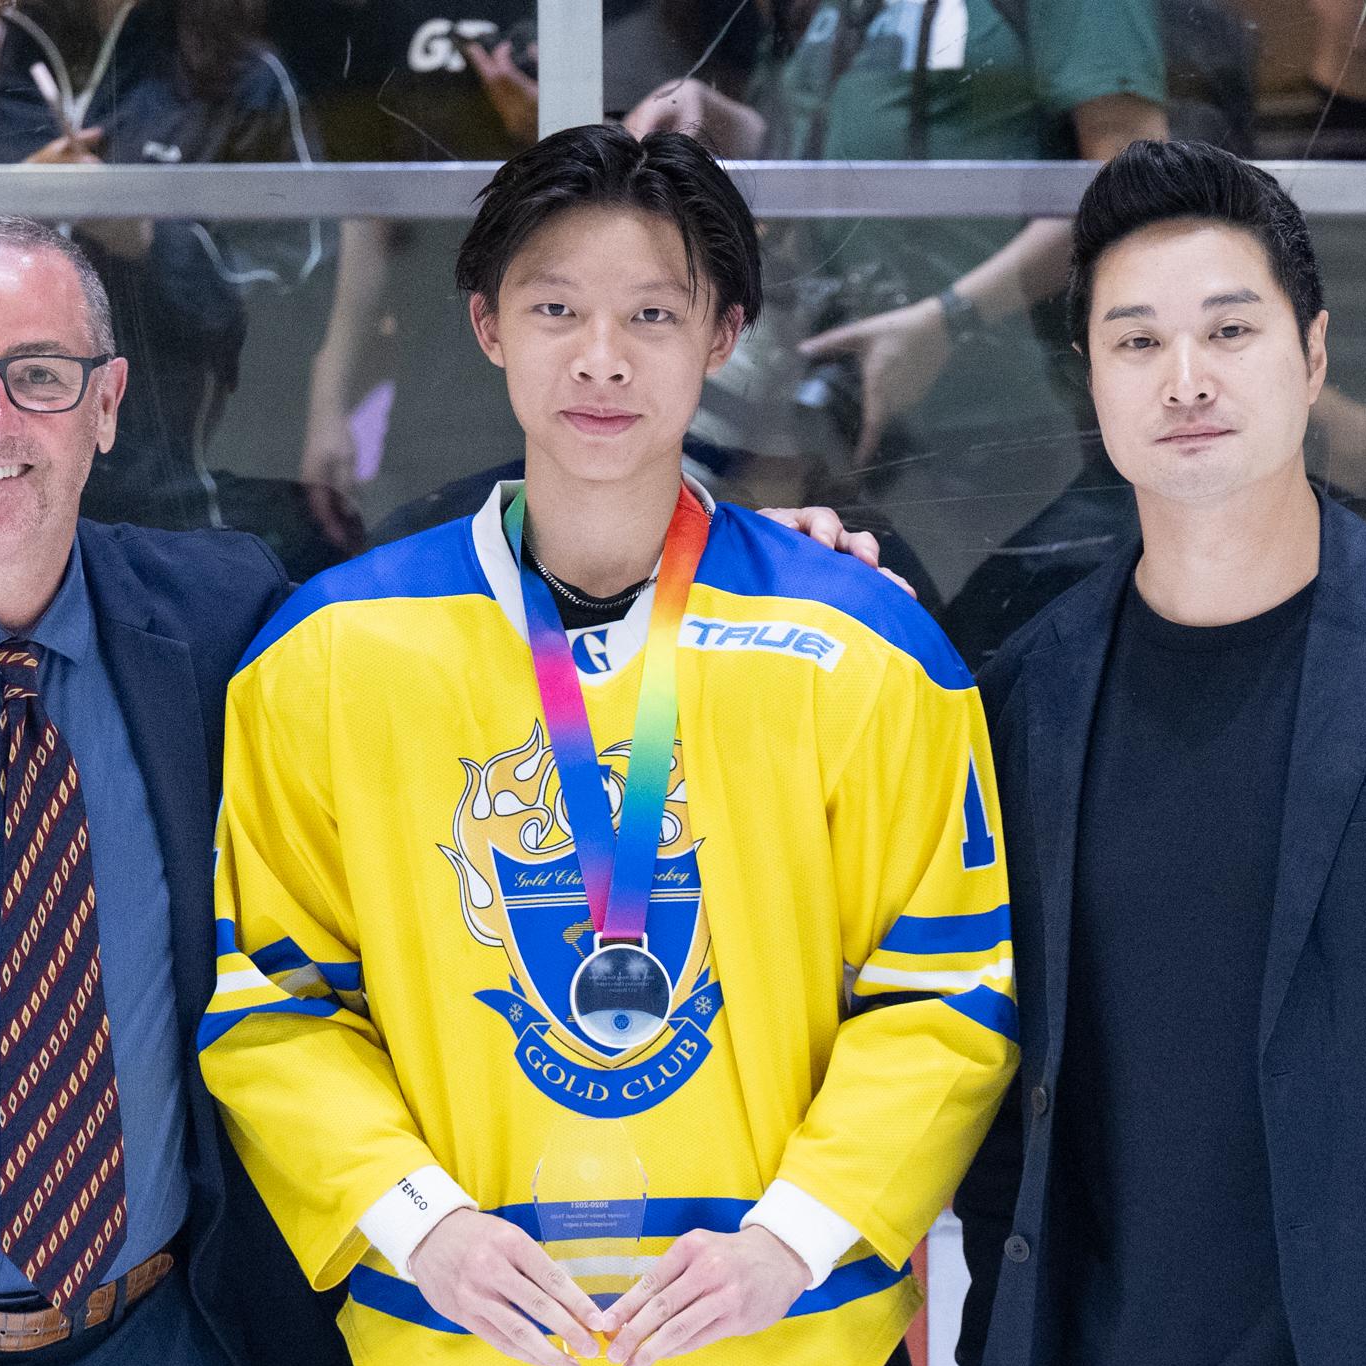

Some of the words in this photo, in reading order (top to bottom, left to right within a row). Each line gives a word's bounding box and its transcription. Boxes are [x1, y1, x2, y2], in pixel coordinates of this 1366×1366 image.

[572, 629, 611, 674] G
[687, 620, 835, 660] TRUE
[514, 871, 553, 888] Gold
[555, 869, 584, 886] Clu
[525, 1045, 609, 1101] GOLD
[621, 1038, 699, 1100] CLUB
